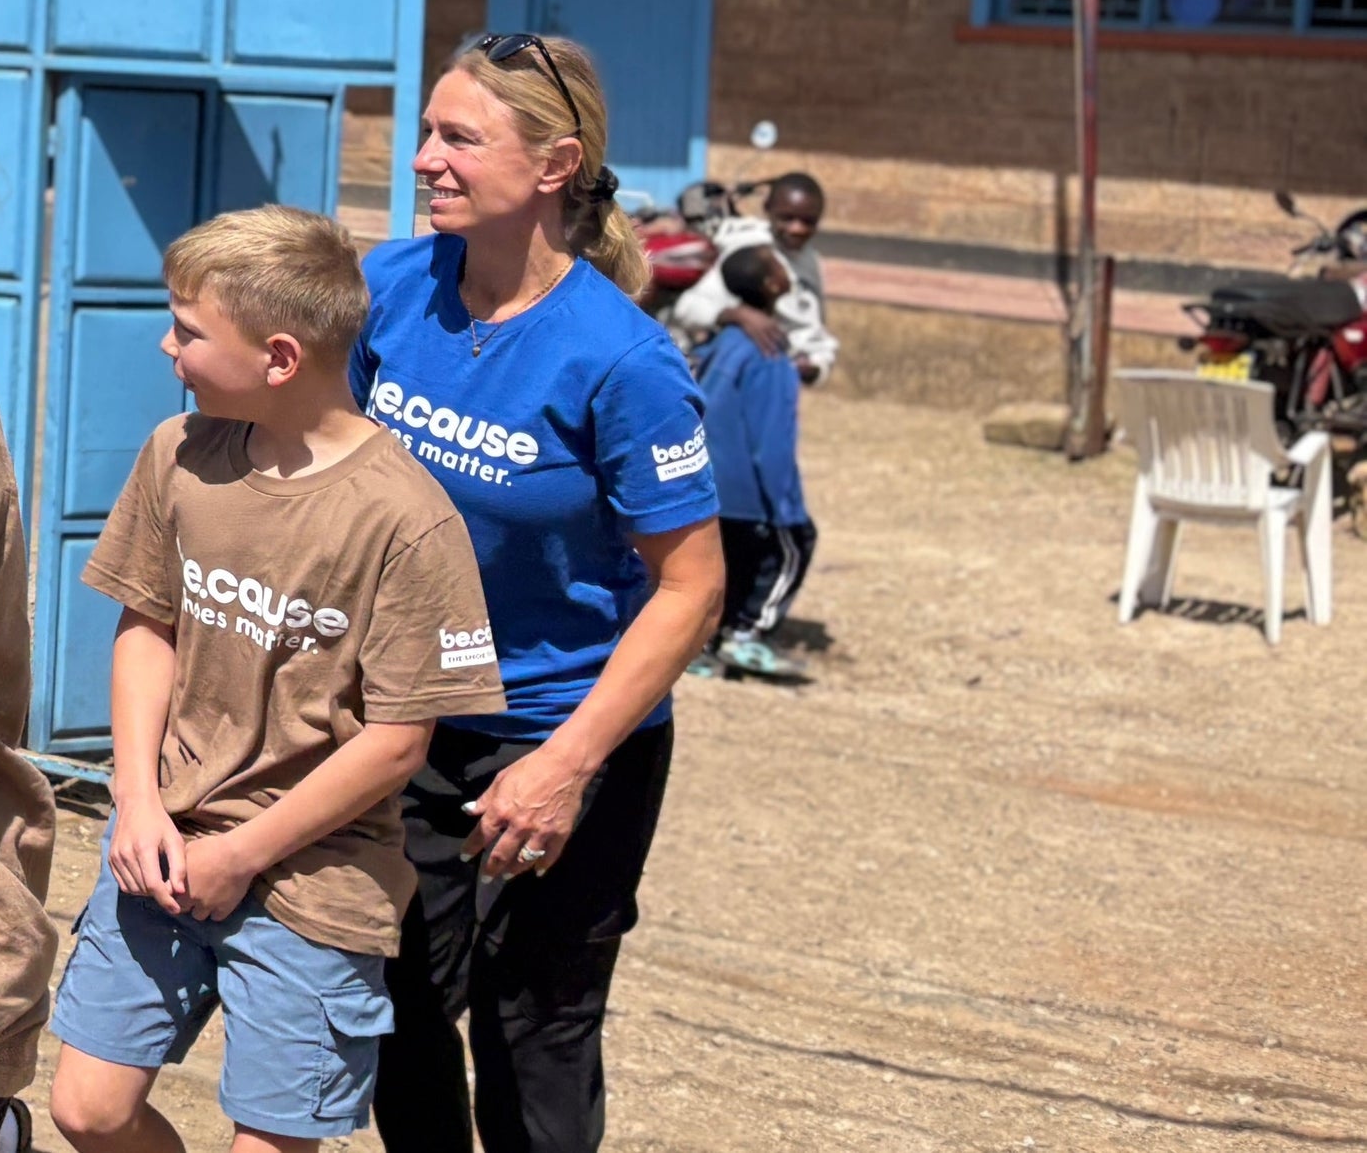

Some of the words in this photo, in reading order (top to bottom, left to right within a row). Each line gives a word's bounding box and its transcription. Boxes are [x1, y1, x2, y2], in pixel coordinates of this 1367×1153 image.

[370, 370, 539, 465] e.cause
[418, 441, 512, 487] matter.
[181, 558, 349, 637] e.cause
